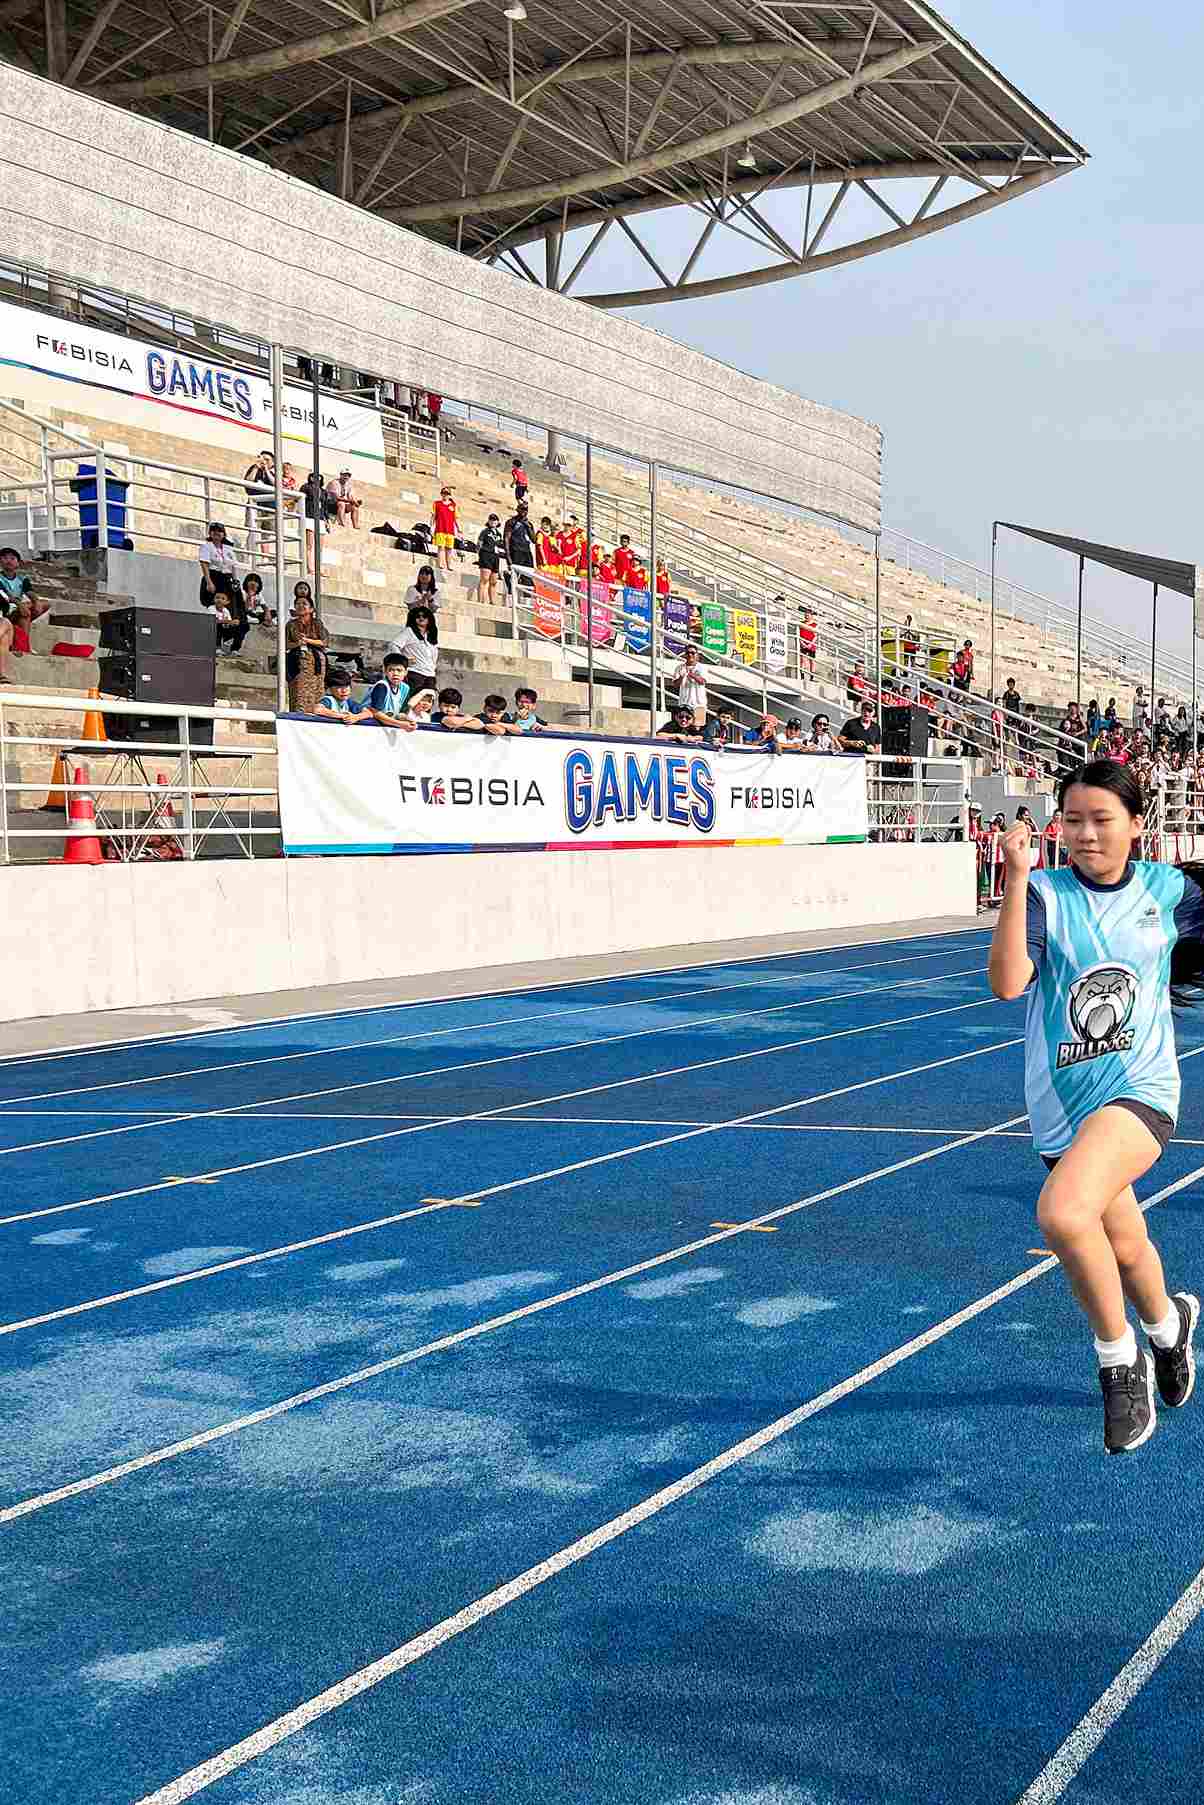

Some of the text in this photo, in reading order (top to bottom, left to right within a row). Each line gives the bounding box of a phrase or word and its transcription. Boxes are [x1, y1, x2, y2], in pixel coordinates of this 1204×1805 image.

[146, 350, 254, 420] GAMES
[399, 749, 815, 833] FOBISIA GAMES FOBISIA
[1056, 1029, 1136, 1069] BULLDOGS
